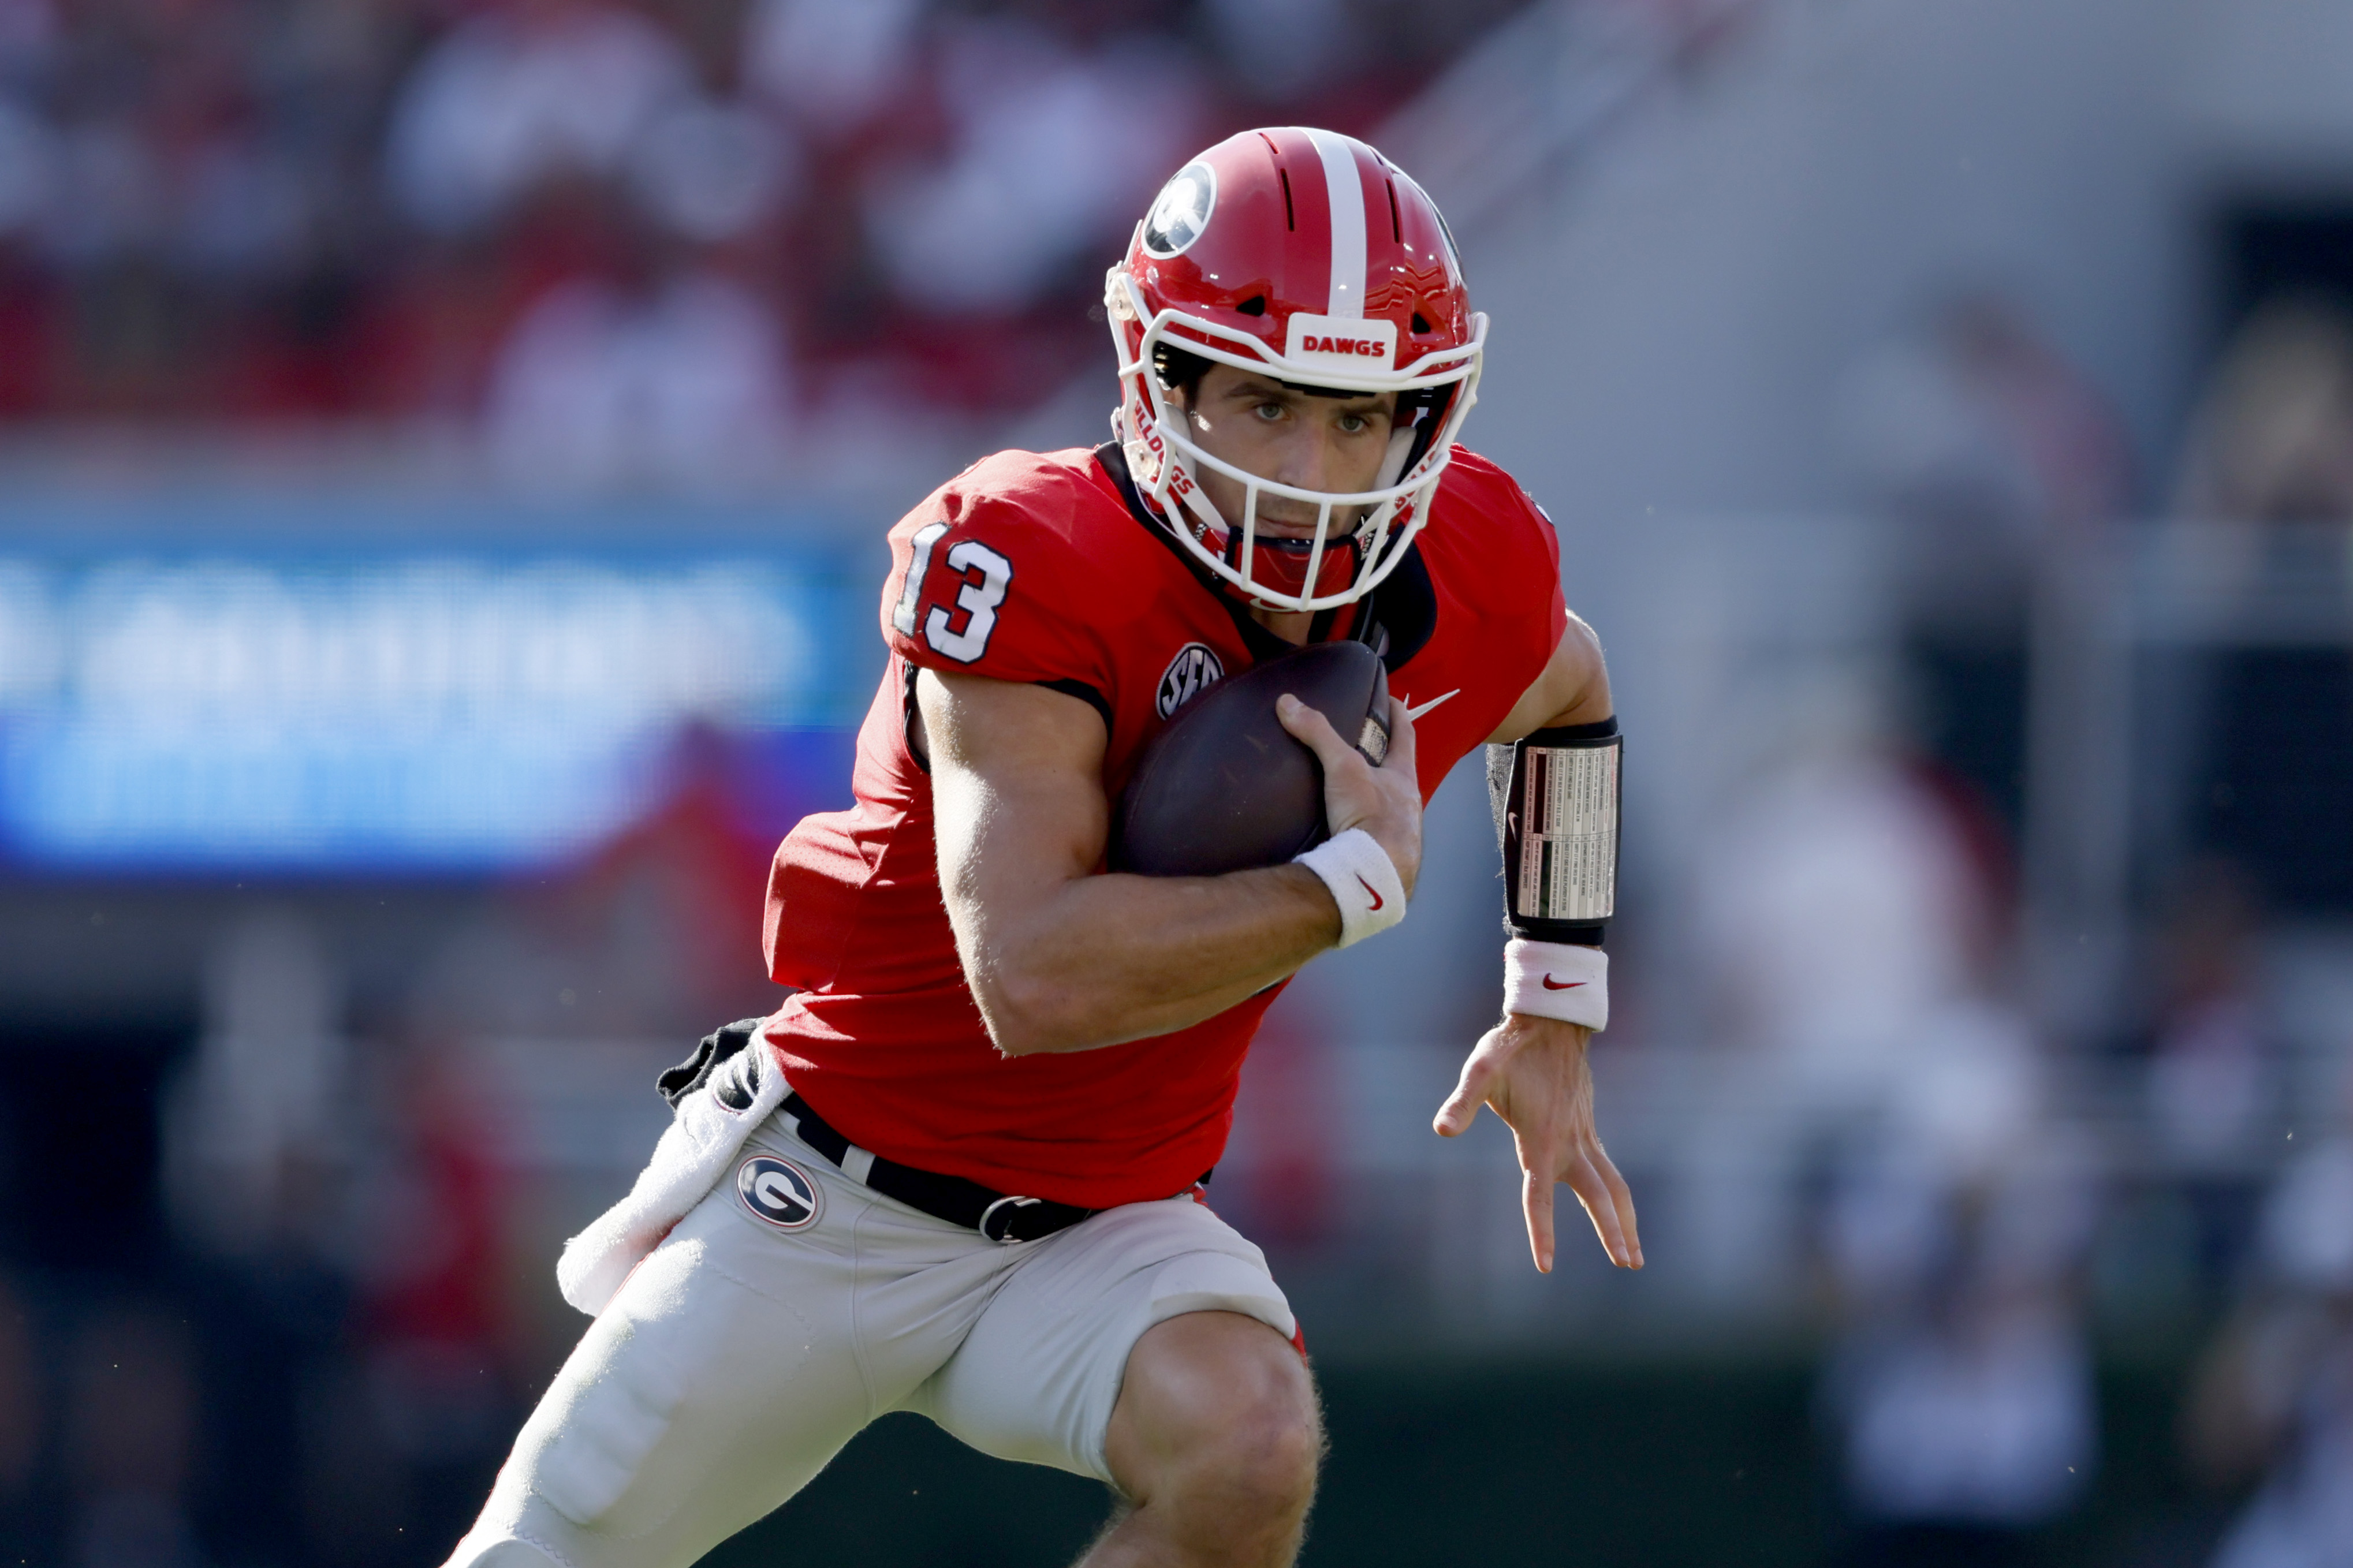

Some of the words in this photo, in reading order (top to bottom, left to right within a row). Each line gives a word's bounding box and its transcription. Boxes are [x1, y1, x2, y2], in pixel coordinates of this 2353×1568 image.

[1303, 335, 1385, 357] DAWGS
[1135, 399, 1195, 495] ULLDGS
[892, 520, 1014, 664] 13
[755, 1171, 814, 1212] G
